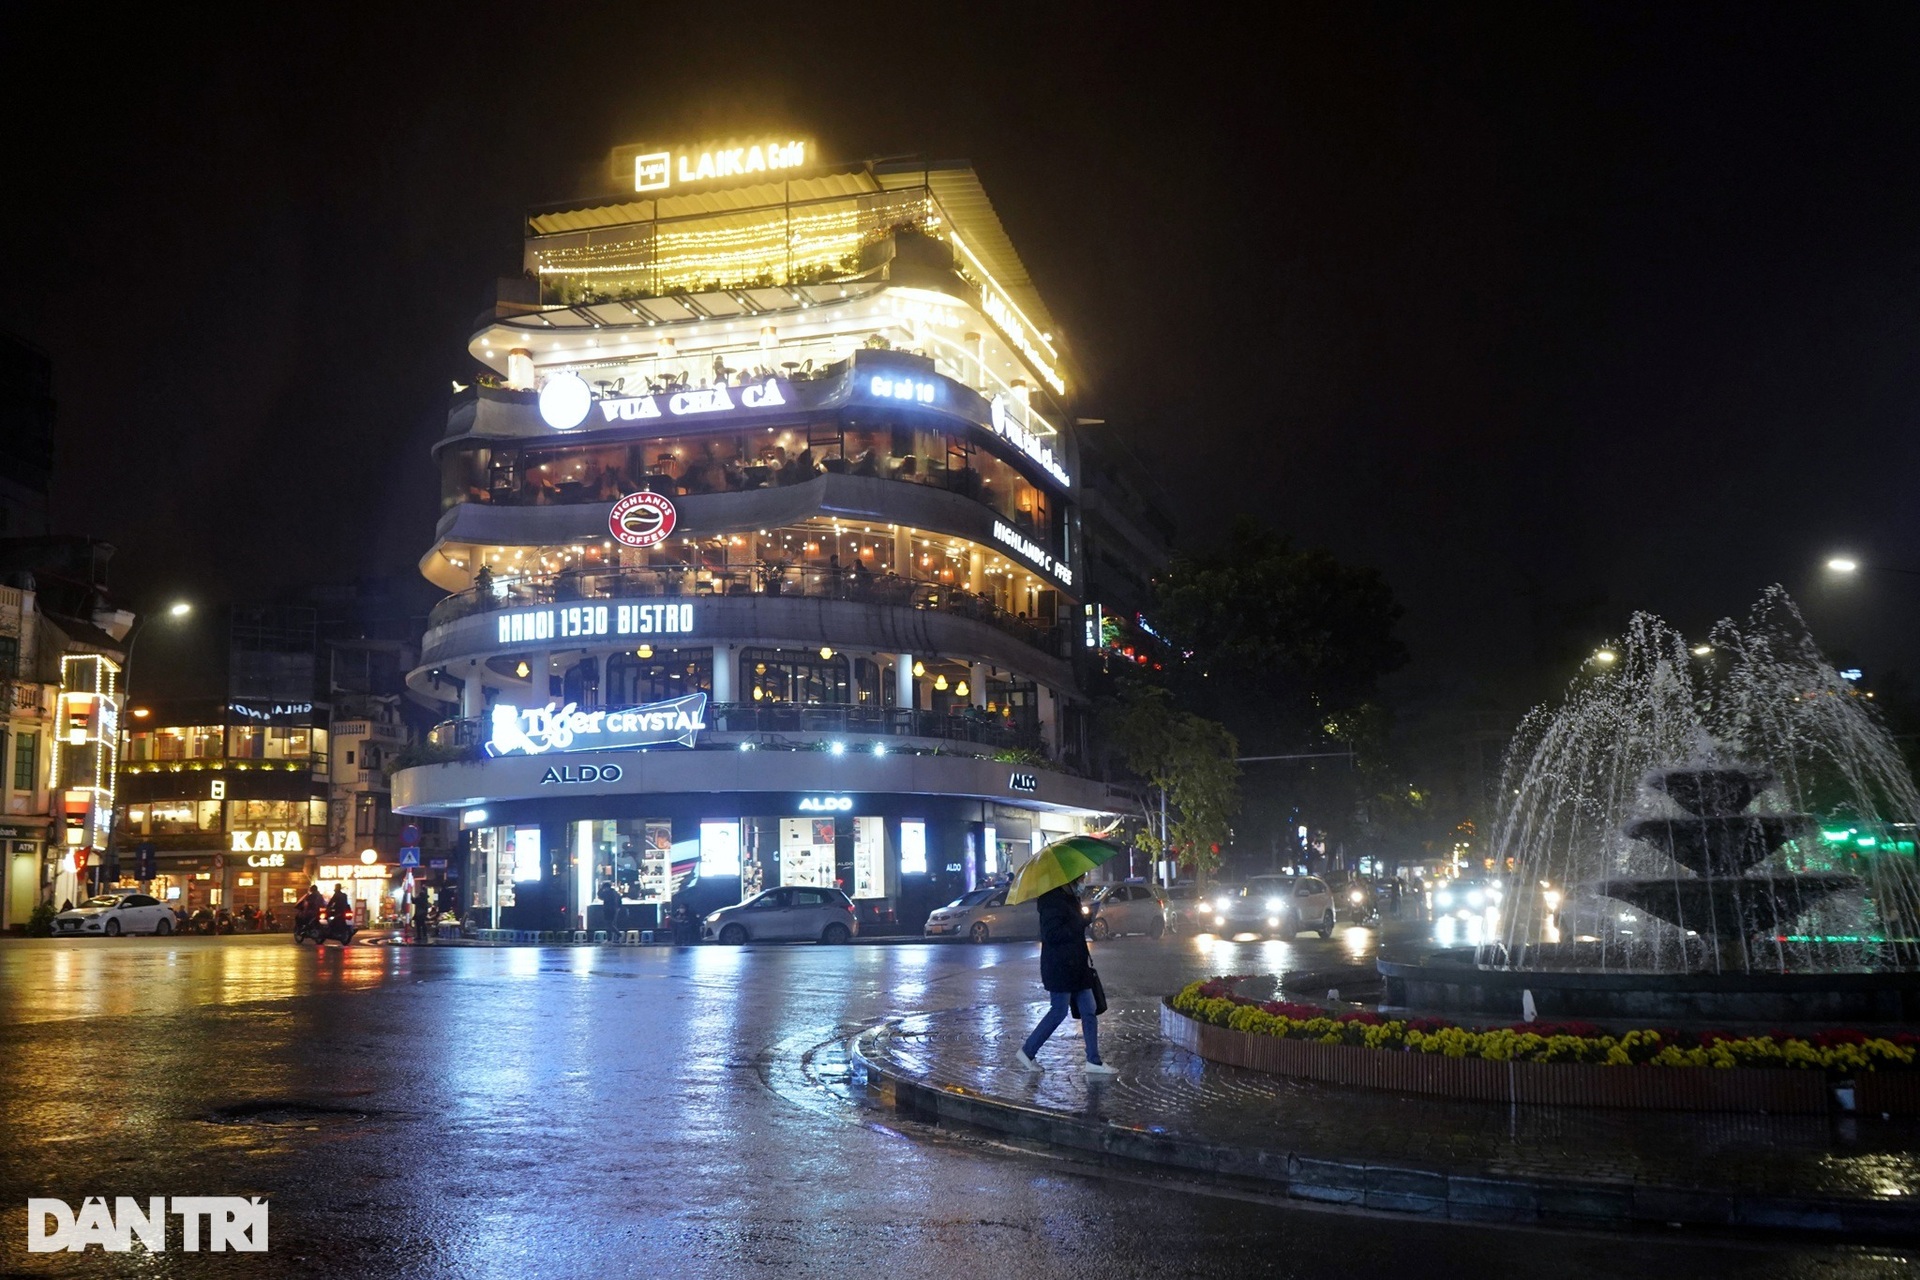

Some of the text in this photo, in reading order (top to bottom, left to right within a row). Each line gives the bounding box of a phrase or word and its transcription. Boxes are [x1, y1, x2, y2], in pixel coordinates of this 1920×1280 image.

[678, 140, 804, 182] LAIKA Café
[599, 396, 661, 422] VUA
[742, 378, 786, 408] CÁ
[612, 495, 672, 520] HIGHLANDS
[619, 529, 666, 544] COFFEE
[993, 520, 1045, 567] HIGHLANDS
[499, 604, 694, 643] HANOI 1930 BISTRO
[521, 702, 706, 748] Tiger CRYSTAL
[540, 764, 623, 785] ALDO
[1009, 772, 1038, 792] ALDO
[798, 797, 853, 811] ALDO
[19, 843, 34, 851] ATM
[231, 830, 303, 852] KAFA
[247, 853, 285, 868] Café
[945, 863, 962, 872] ALDO
